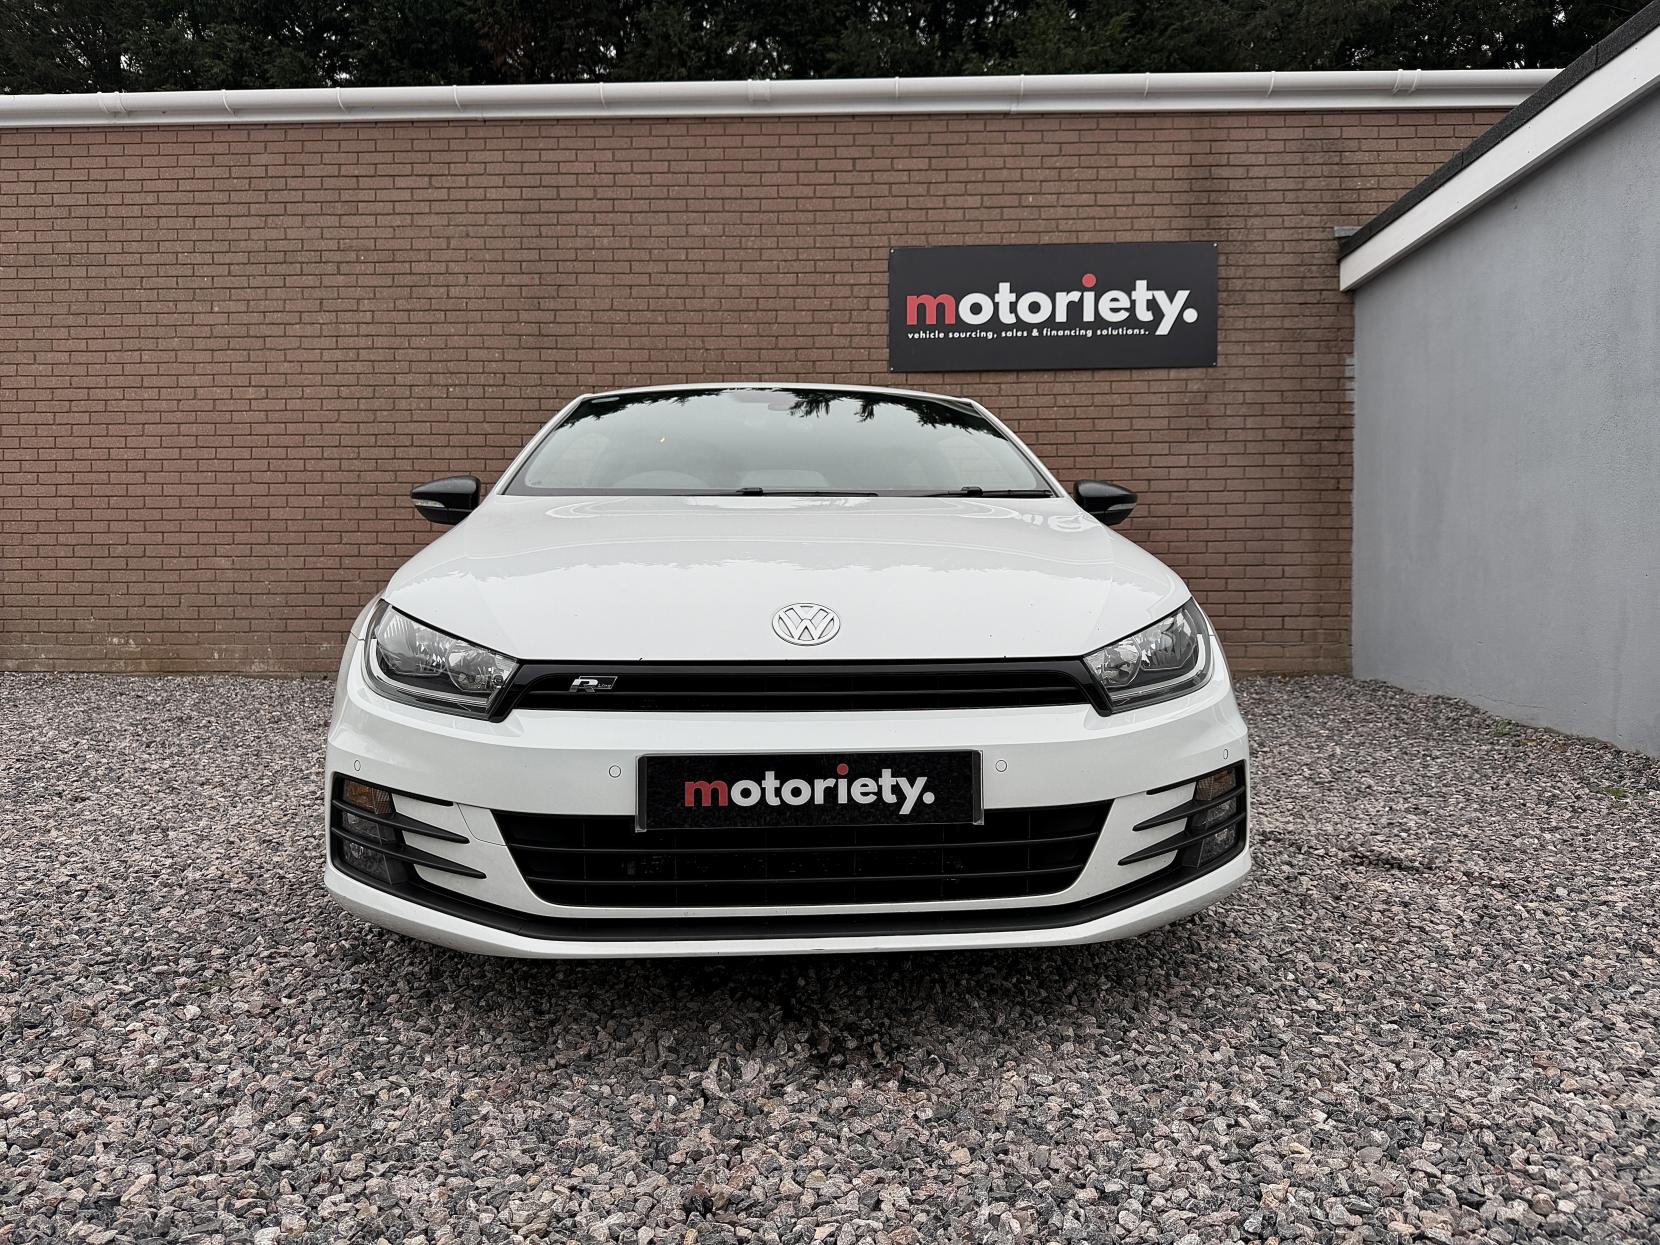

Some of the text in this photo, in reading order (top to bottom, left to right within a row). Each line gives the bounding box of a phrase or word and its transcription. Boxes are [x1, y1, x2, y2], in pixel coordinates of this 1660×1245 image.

[906, 273, 1198, 335] motoriety.
[907, 326, 1149, 340] vehicle sourcing, sales & financing solutions.
[774, 604, 838, 645] VW
[684, 763, 936, 815] motoriety.
